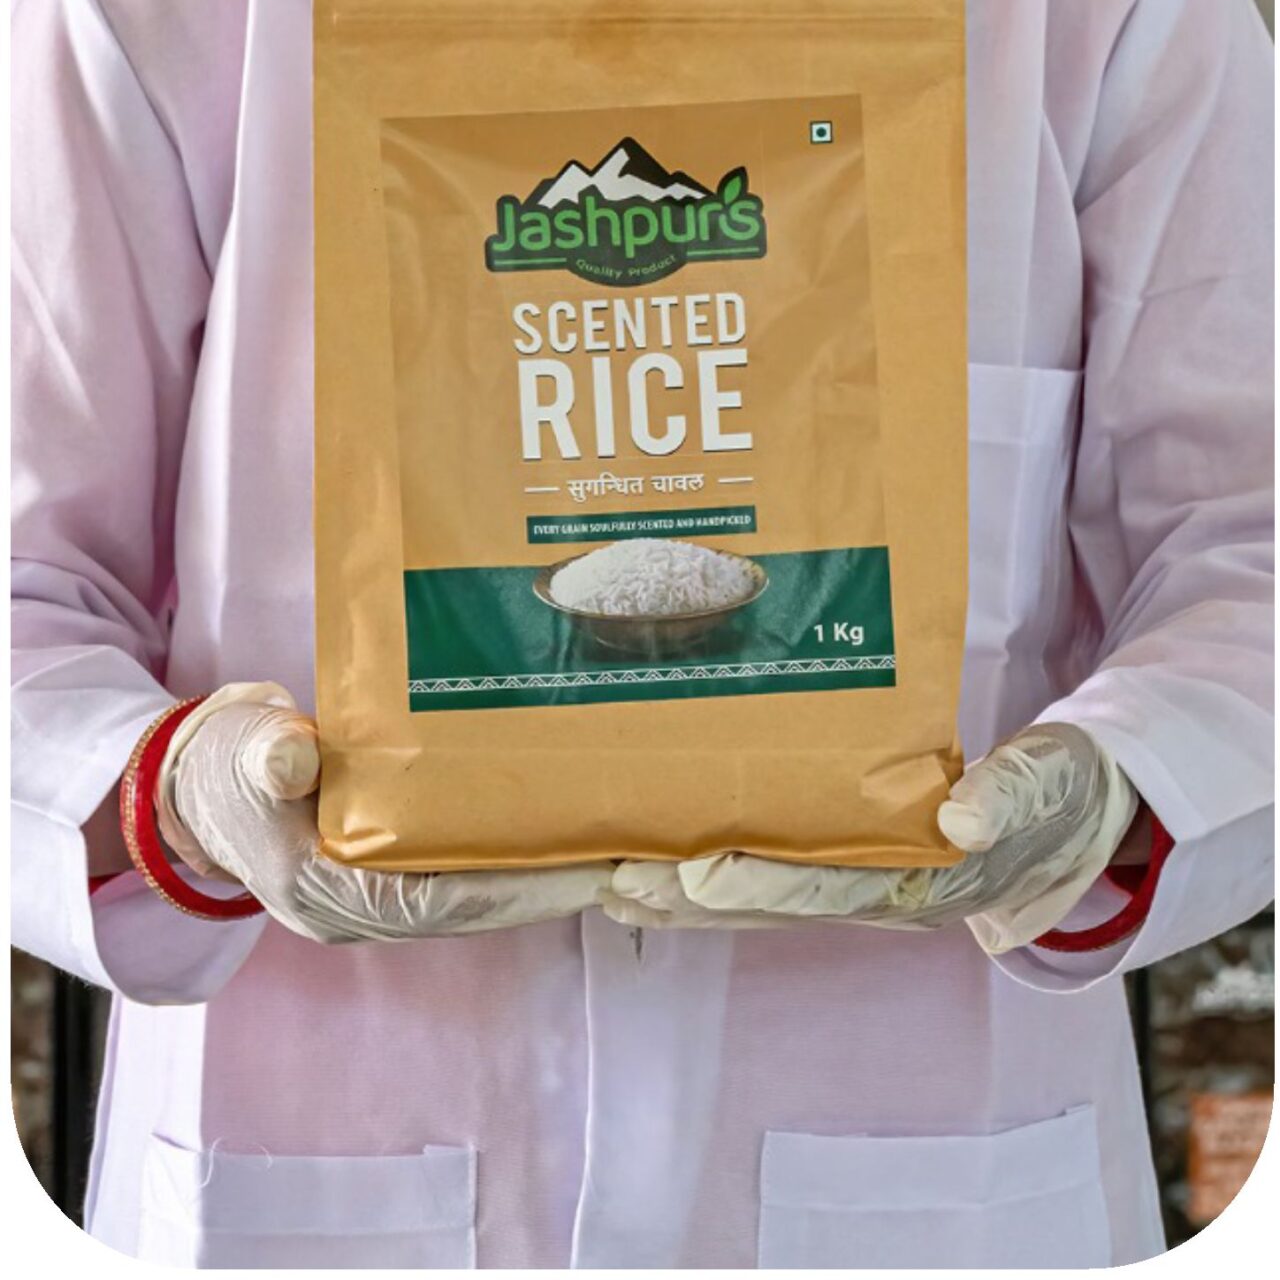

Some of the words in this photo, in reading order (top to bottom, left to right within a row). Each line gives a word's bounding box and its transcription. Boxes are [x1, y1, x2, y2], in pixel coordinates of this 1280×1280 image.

[576, 259, 622, 279] Quality
[628, 255, 676, 277] Product
[512, 292, 747, 355] SCENTED
[517, 348, 753, 460] RICE
[566, 472, 645, 503] सुगन्धित
[651, 473, 705, 494] चावल
[676, 517, 695, 529] AND
[813, 624, 824, 643] 1
[833, 622, 864, 646] Kg
